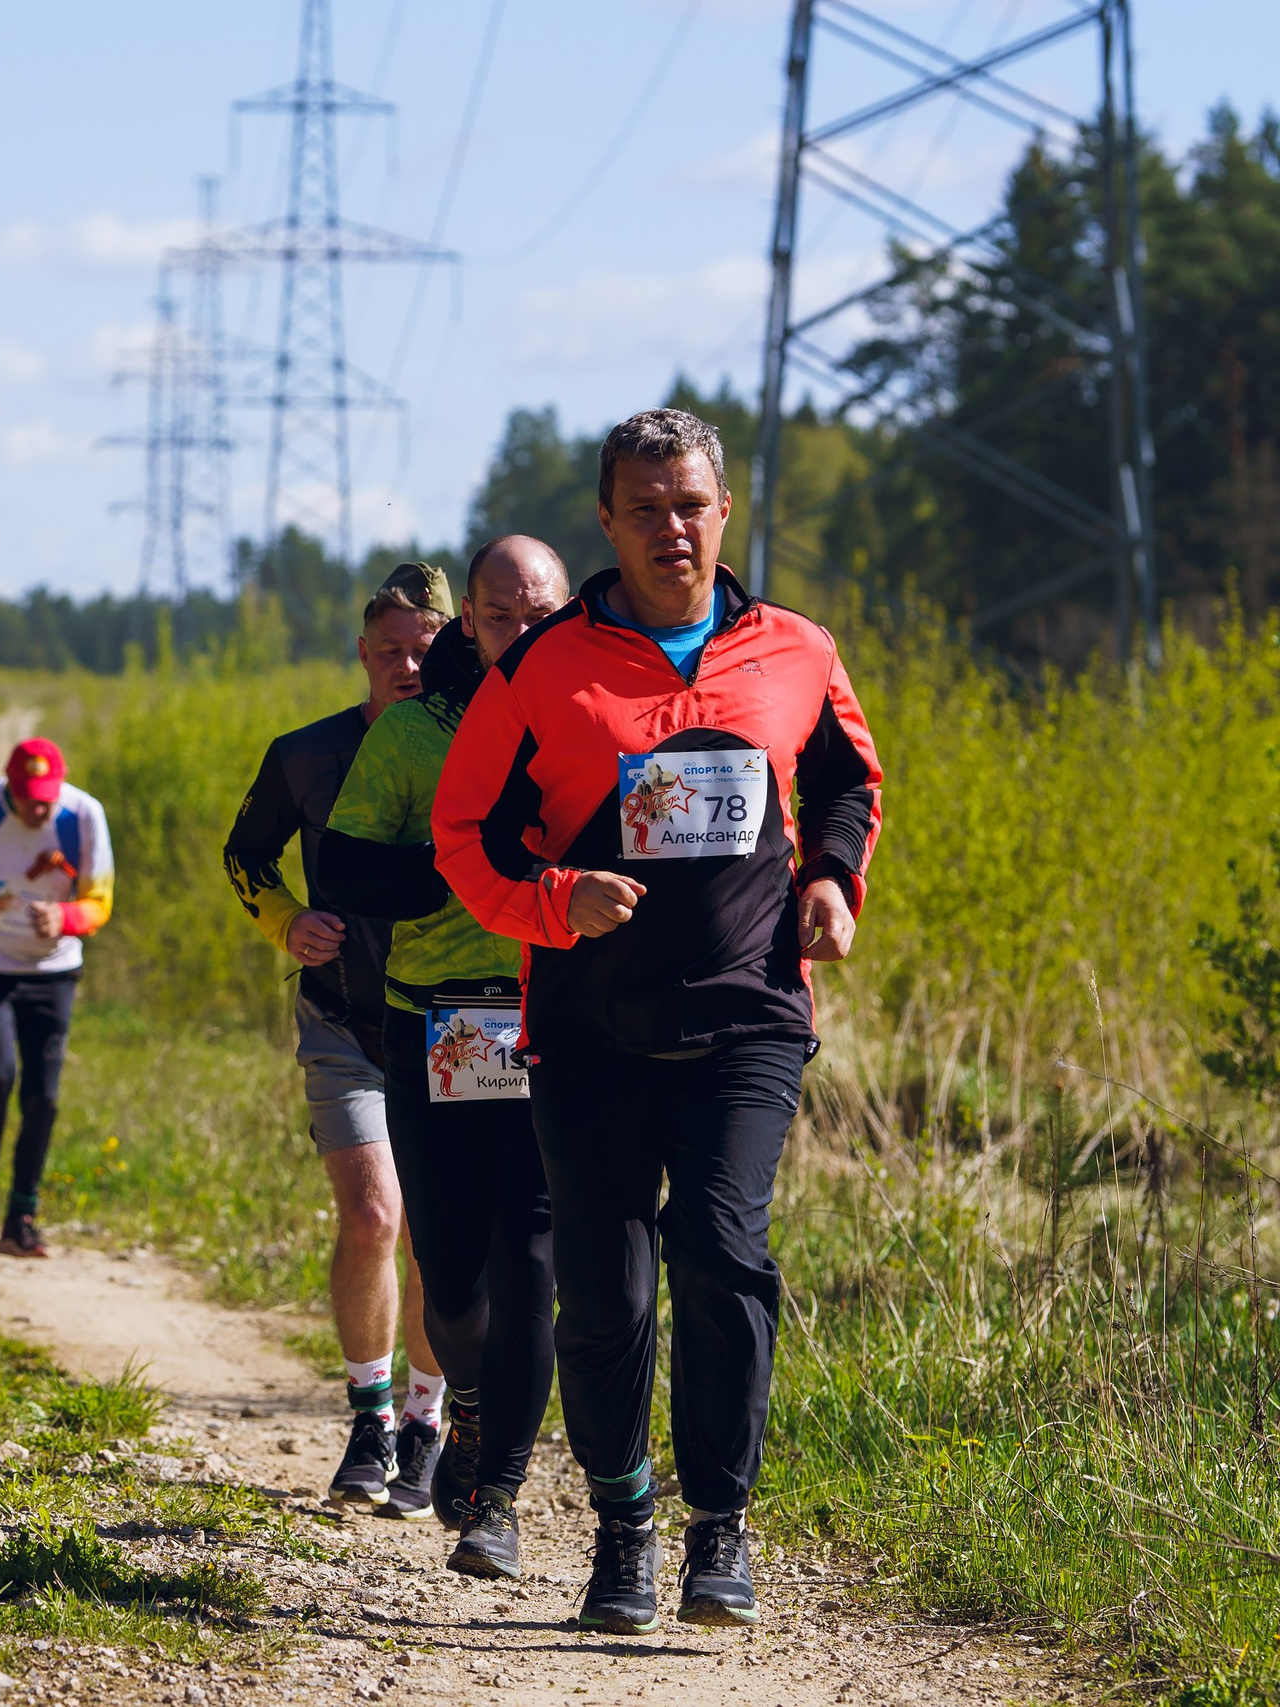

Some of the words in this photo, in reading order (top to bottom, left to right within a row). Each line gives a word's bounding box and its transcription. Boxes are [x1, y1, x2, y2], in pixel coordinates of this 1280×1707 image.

[684, 766, 719, 775] СПОРТ
[719, 765, 733, 774] 40
[704, 794, 748, 823] 78
[660, 829, 755, 845] Александр
[476, 1075, 529, 1090] Кирил
